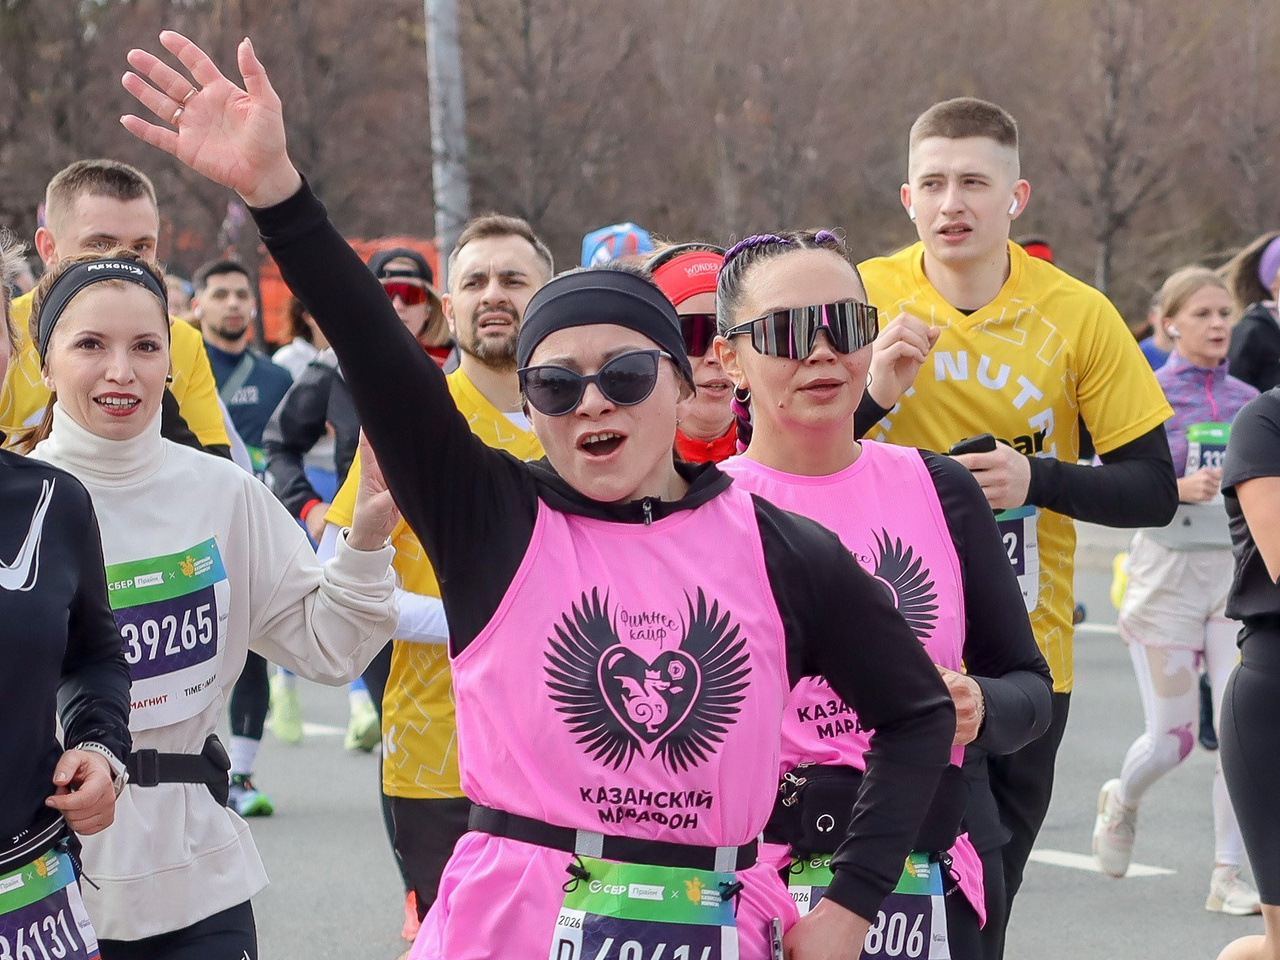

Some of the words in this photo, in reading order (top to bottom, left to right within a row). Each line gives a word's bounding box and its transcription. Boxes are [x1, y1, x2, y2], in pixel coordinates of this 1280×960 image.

[108, 580, 133, 591] СБЕР
[121, 603, 213, 664] 39265
[579, 786, 713, 809] КАЗАНСКИЙ
[598, 806, 698, 829] МАРАФОН
[557, 915, 581, 929] 2026
